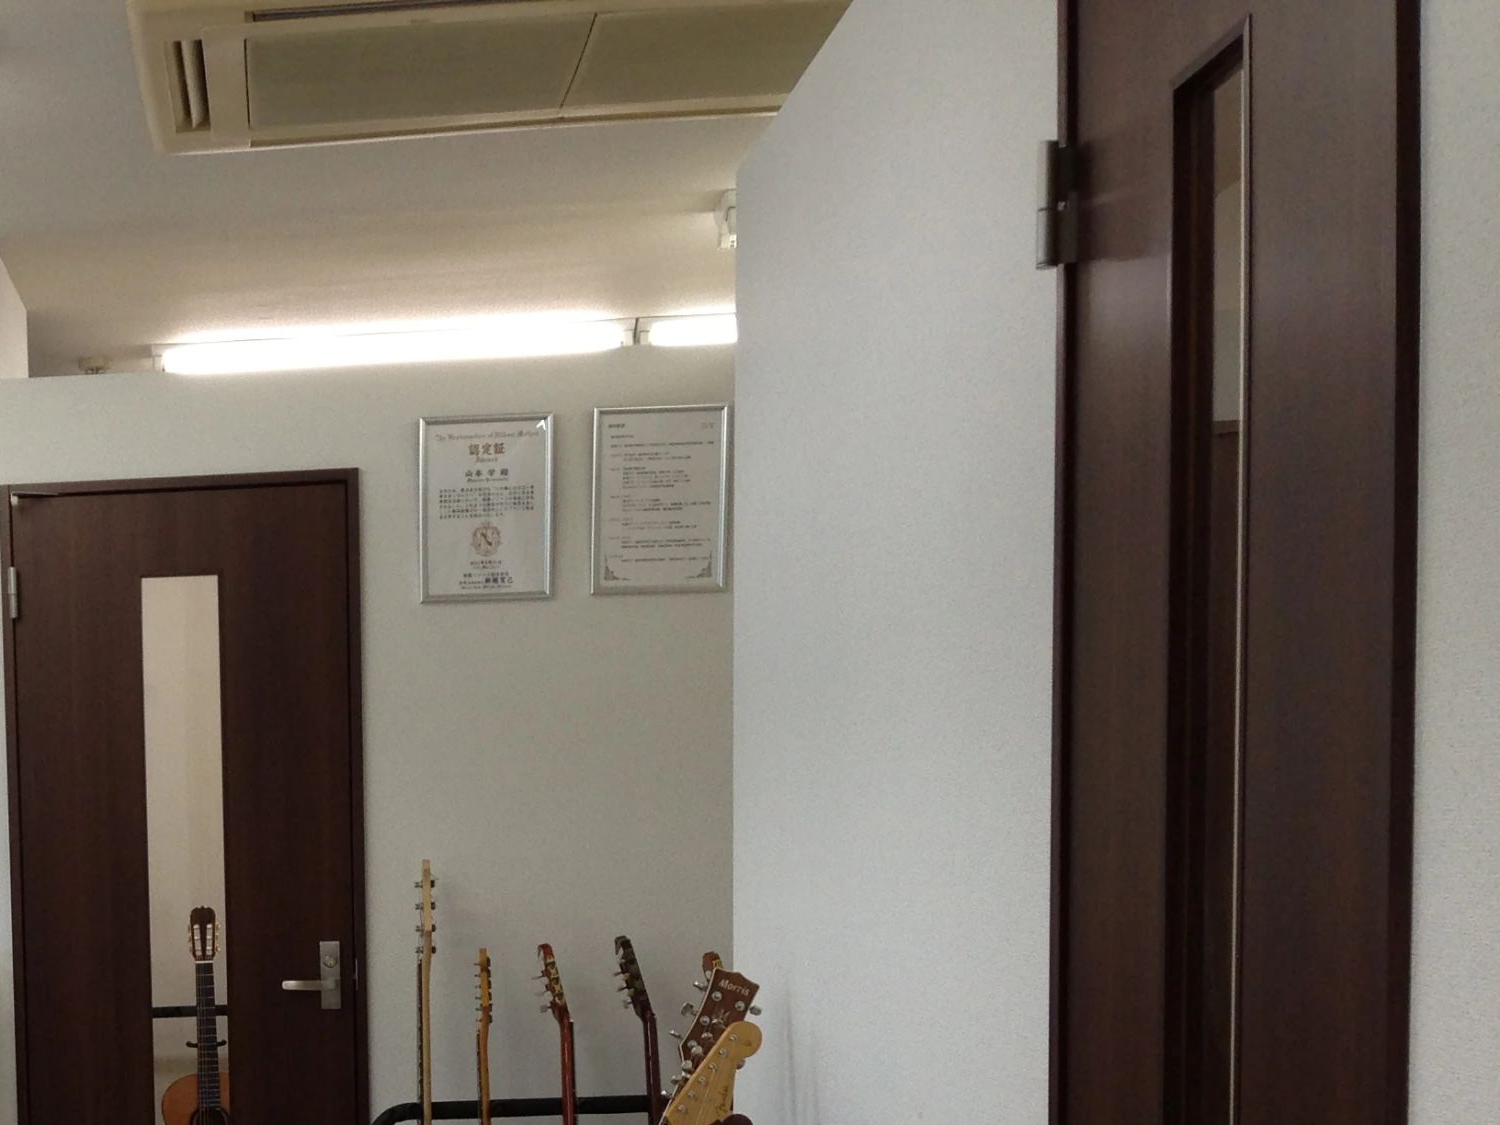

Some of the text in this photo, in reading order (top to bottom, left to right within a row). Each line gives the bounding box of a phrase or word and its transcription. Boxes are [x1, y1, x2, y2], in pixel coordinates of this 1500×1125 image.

[468, 442, 506, 456] 認定証
[719, 978, 750, 996] Morris
